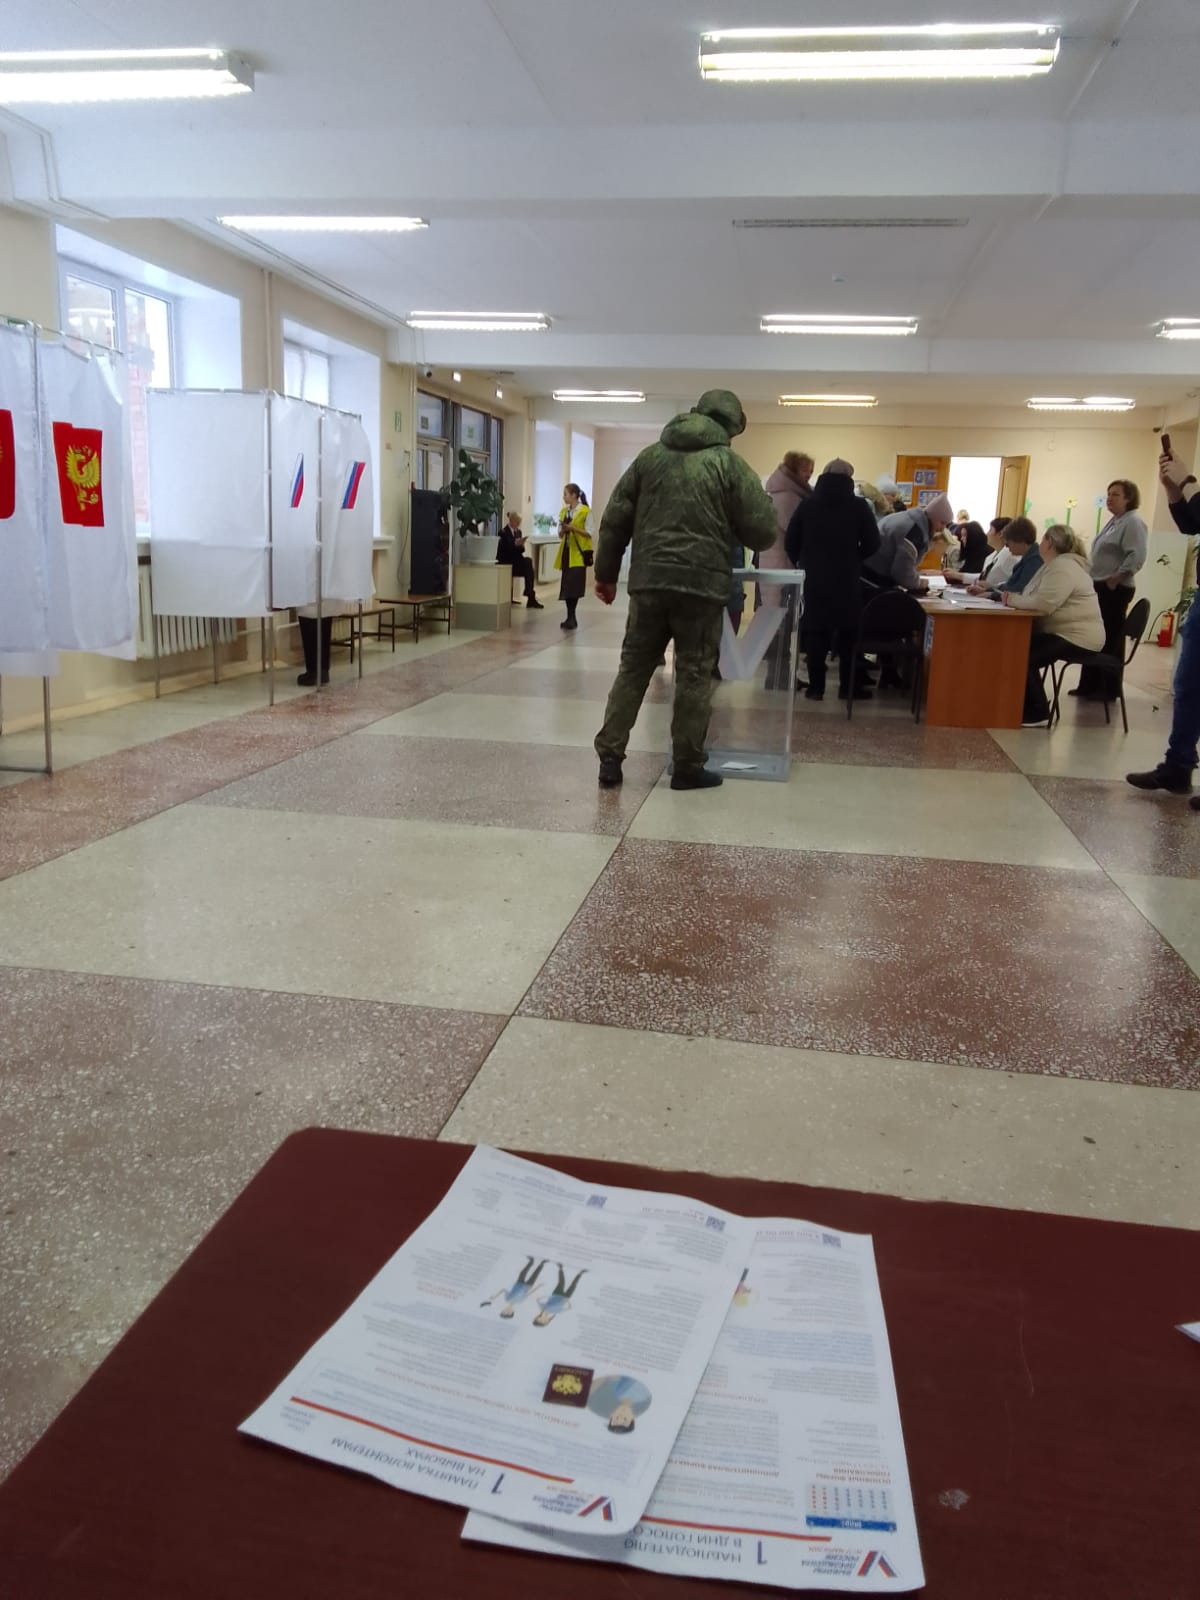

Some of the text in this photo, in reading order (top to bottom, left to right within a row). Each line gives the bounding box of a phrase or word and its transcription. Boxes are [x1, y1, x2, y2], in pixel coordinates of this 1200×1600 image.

[330, 1436, 479, 1490] ПАМЯТКА ВОЛОНТЕРАМ
[406, 1446, 486, 1478] НА ВЫБОРАХ
[490, 1474, 506, 1496] 1
[628, 1526, 742, 1549] В ДНИ ГОЛОСО
[624, 1538, 743, 1564] НАБЛЮДАТЕЛЮ
[756, 1540, 769, 1565] 1
